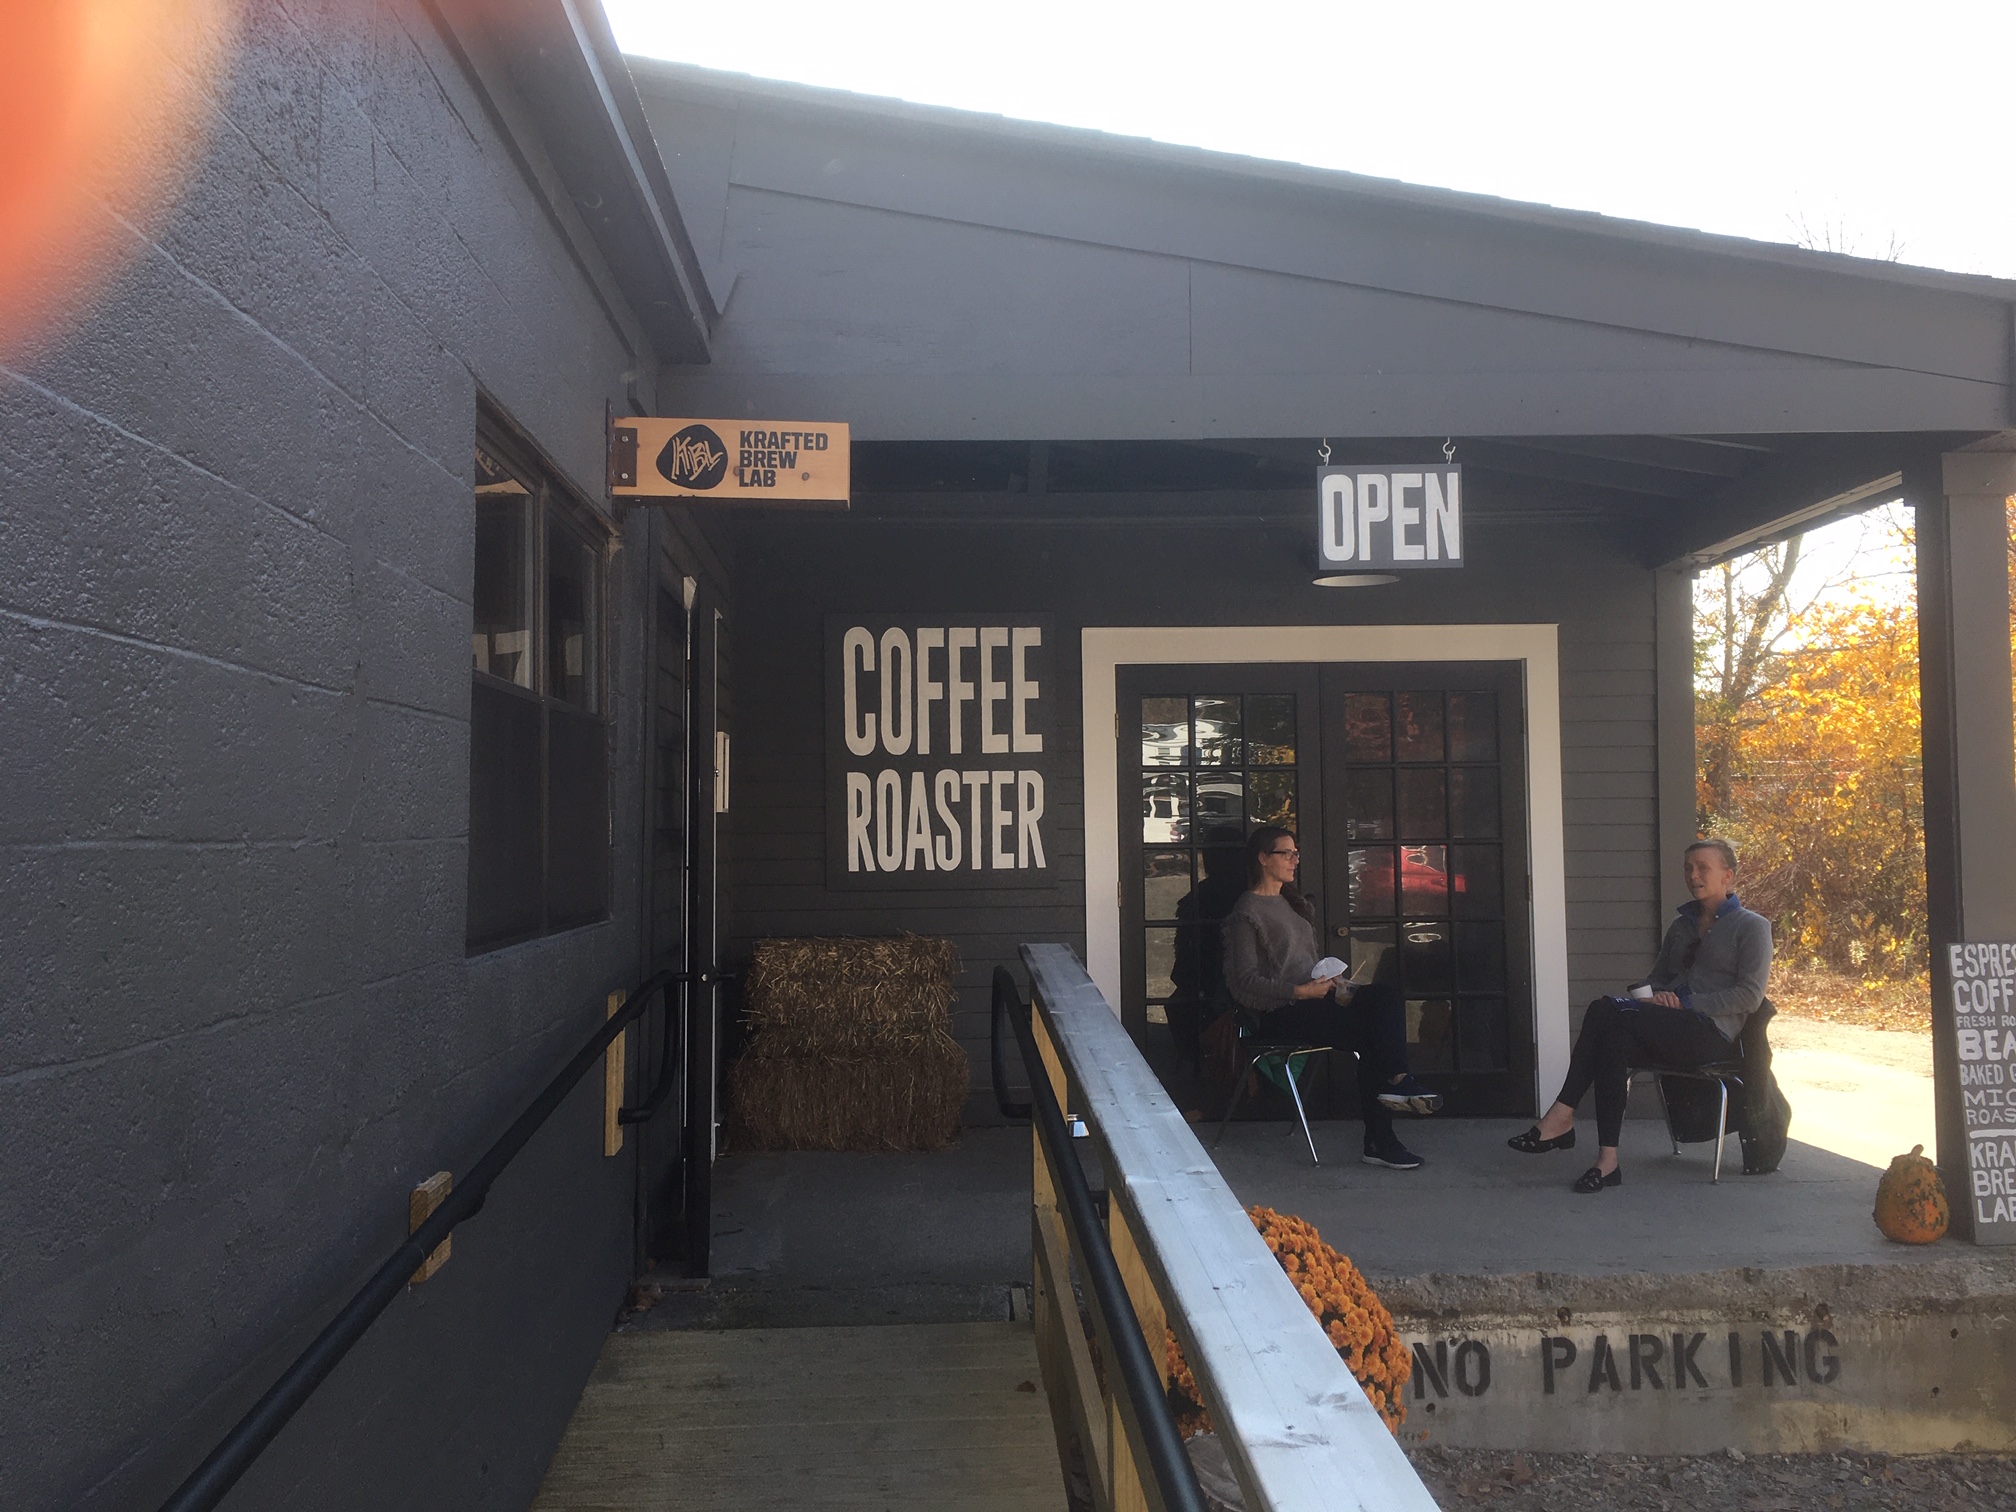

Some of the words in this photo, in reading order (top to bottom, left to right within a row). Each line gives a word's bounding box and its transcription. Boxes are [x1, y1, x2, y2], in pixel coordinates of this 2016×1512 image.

[740, 430, 829, 451] KRAFTED
[671, 435, 724, 481] KBL
[740, 450, 798, 469] BREW
[739, 469, 776, 487] LAB
[1321, 472, 1461, 562] OPEN
[843, 626, 1043, 756] COFFEE
[846, 768, 1047, 872] ROASTER
[1956, 1015, 1996, 1029] FRESH
[1959, 1063, 2004, 1086] BAKED
[1411, 1340, 1491, 1399] NO
[1541, 1328, 1840, 1395] PARKING
